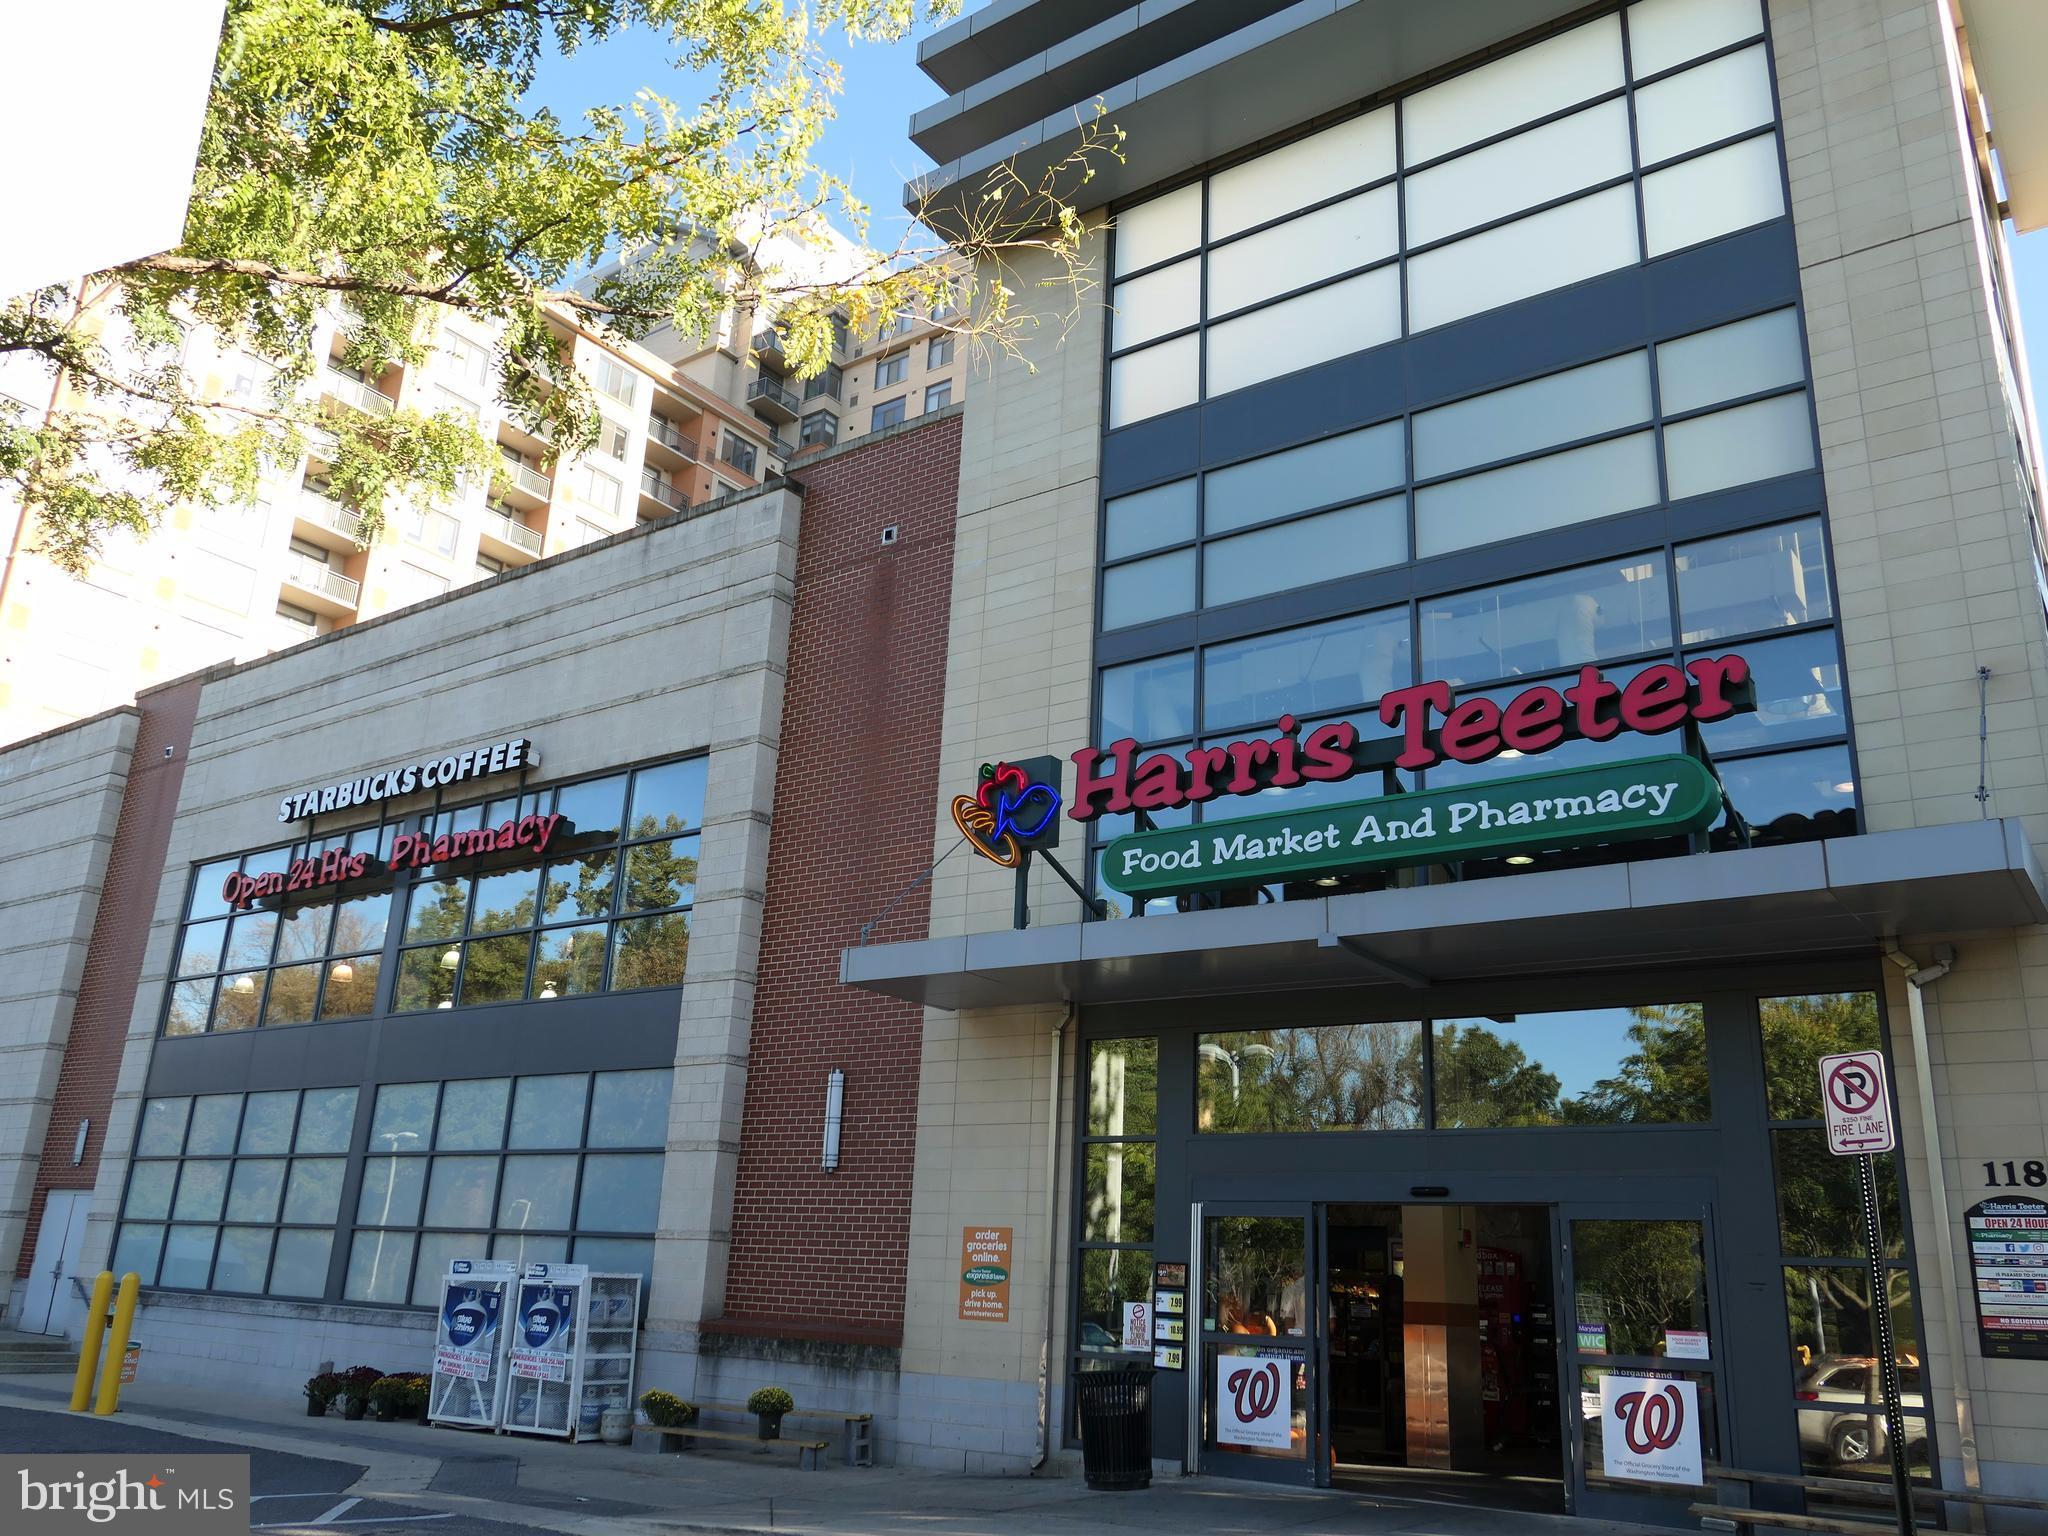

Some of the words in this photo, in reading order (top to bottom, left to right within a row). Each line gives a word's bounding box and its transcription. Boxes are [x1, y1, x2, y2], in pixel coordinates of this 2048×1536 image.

[1068, 714, 1359, 821] Harris
[1380, 654, 1749, 773] Teeter
[278, 765, 417, 823] STARBUCKS
[421, 738, 525, 789] COFFEE
[1122, 839, 1202, 876] Food
[1212, 823, 1341, 865] Market
[1351, 814, 1437, 847] And
[1449, 782, 1679, 834] Pharmacy
[222, 871, 283, 909] Open
[286, 859, 315, 892] 24
[317, 847, 367, 885] Hrs
[388, 813, 560, 871] Pharmacy
[1842, 1116, 1857, 1124] $250
[1833, 1123, 1855, 1137] FIRE
[1858, 1121, 1885, 1135] LANE
[1982, 1160, 2047, 1188] 118
[1990, 1202, 2017, 1210] Harris
[1984, 1218, 2008, 1228] OPEN
[2009, 1218, 2023, 1228] 24
[975, 1229, 1000, 1240] order
[966, 1241, 1007, 1252] groceries
[972, 1252, 1000, 1262] online.
[1477, 1251, 1497, 1260] dbox
[971, 1289, 986, 1298] pick
[986, 1291, 997, 1299] up.
[964, 1299, 981, 1308] drive
[982, 1300, 1003, 1309] home.
[1170, 1297, 1183, 1308] 7.99
[1170, 1325, 1183, 1334] 10.99
[1578, 1325, 1603, 1333] Maryland
[1579, 1335, 1604, 1347] WIC
[1266, 1347, 1293, 1355] organic
[1168, 1353, 1180, 1363] 7.99
[1621, 1369, 1655, 1378] organic
[1655, 1371, 1673, 1379] and
[1227, 1362, 1281, 1424] W
[1614, 1384, 1684, 1454] W
[1641, 1462, 1660, 1470] Grocery
[1626, 1468, 1655, 1476] Washington
